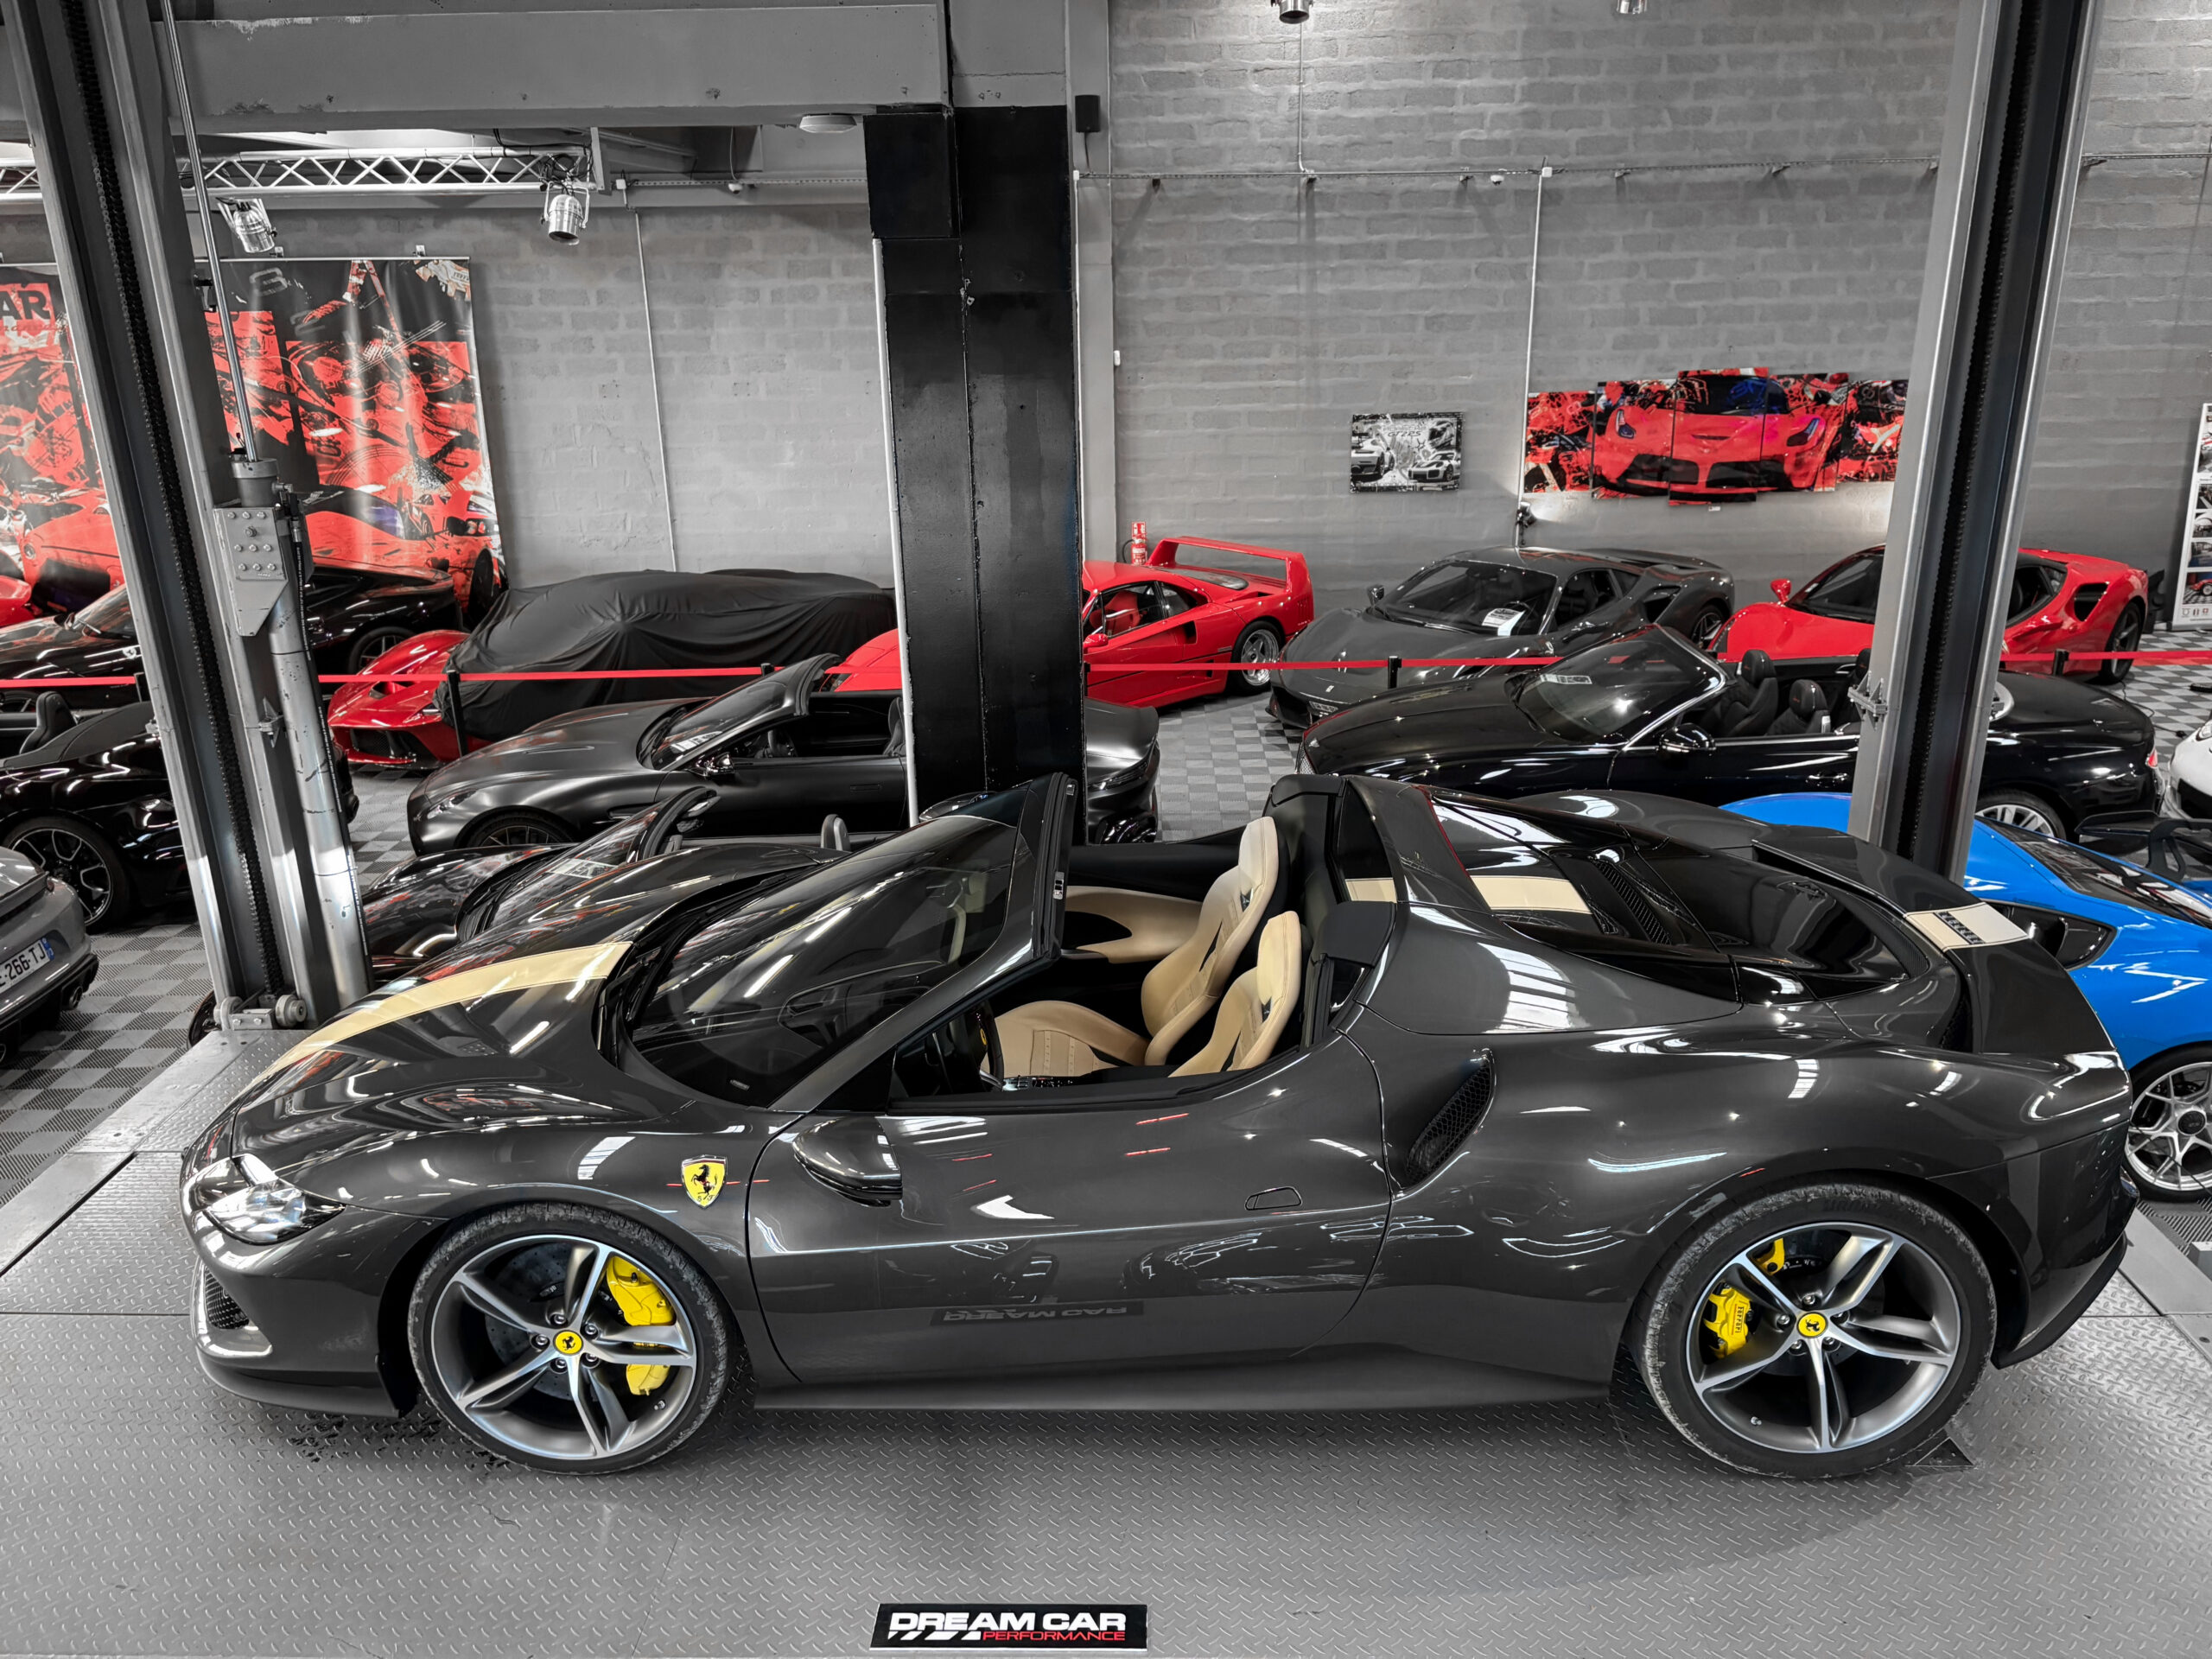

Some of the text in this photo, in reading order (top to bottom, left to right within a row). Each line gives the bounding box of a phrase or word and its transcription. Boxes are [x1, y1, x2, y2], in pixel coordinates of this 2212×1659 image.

[0, 942, 46, 986] -266-TJ
[889, 1611, 1127, 1631] DREAM CAR
[982, 1631, 1126, 1641] PERFORMANCE
